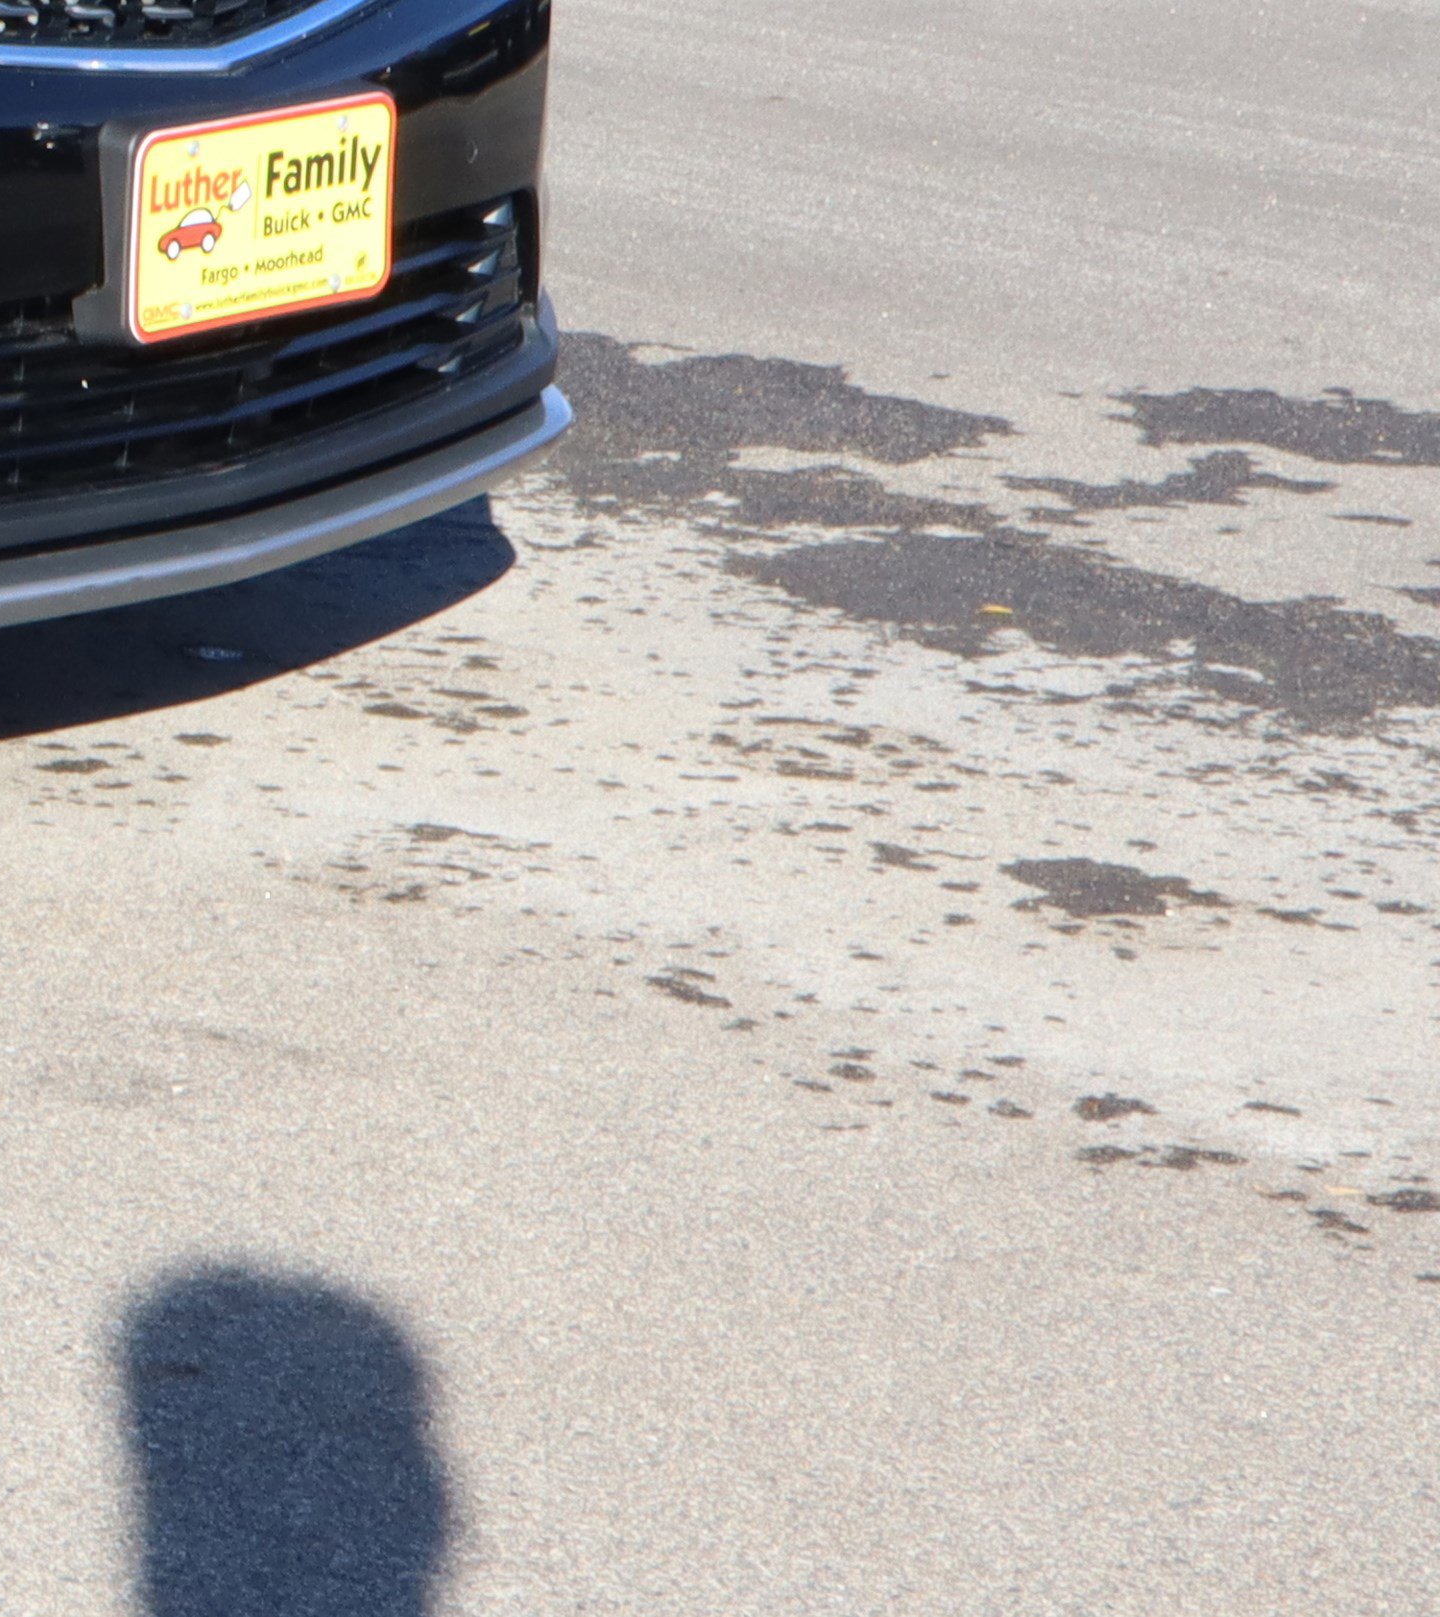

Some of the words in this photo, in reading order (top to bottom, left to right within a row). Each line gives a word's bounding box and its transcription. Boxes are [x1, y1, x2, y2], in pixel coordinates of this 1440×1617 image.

[150, 165, 243, 213] Luther
[265, 135, 382, 199] Family
[263, 214, 310, 238] Buick
[332, 196, 372, 224] GMC
[201, 264, 239, 286] Fargo
[254, 245, 324, 274] Moorhead
